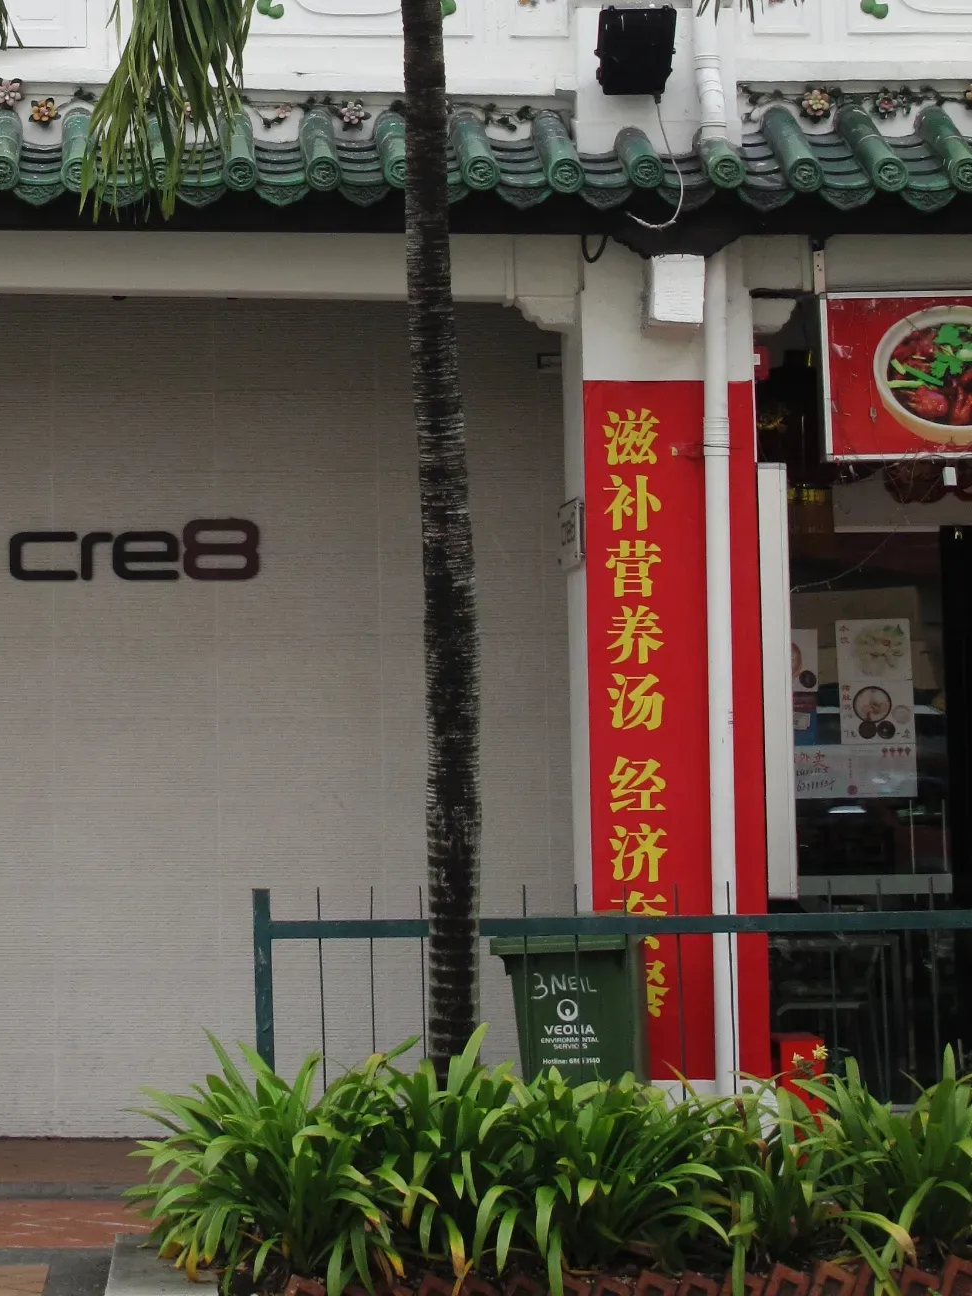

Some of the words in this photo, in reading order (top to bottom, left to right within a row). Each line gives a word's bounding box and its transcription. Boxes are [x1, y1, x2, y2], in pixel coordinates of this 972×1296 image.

[9, 518, 261, 582] cre8
[602, 408, 665, 731] 滋补营养汤
[543, 1024, 595, 1035] VEOLIA
